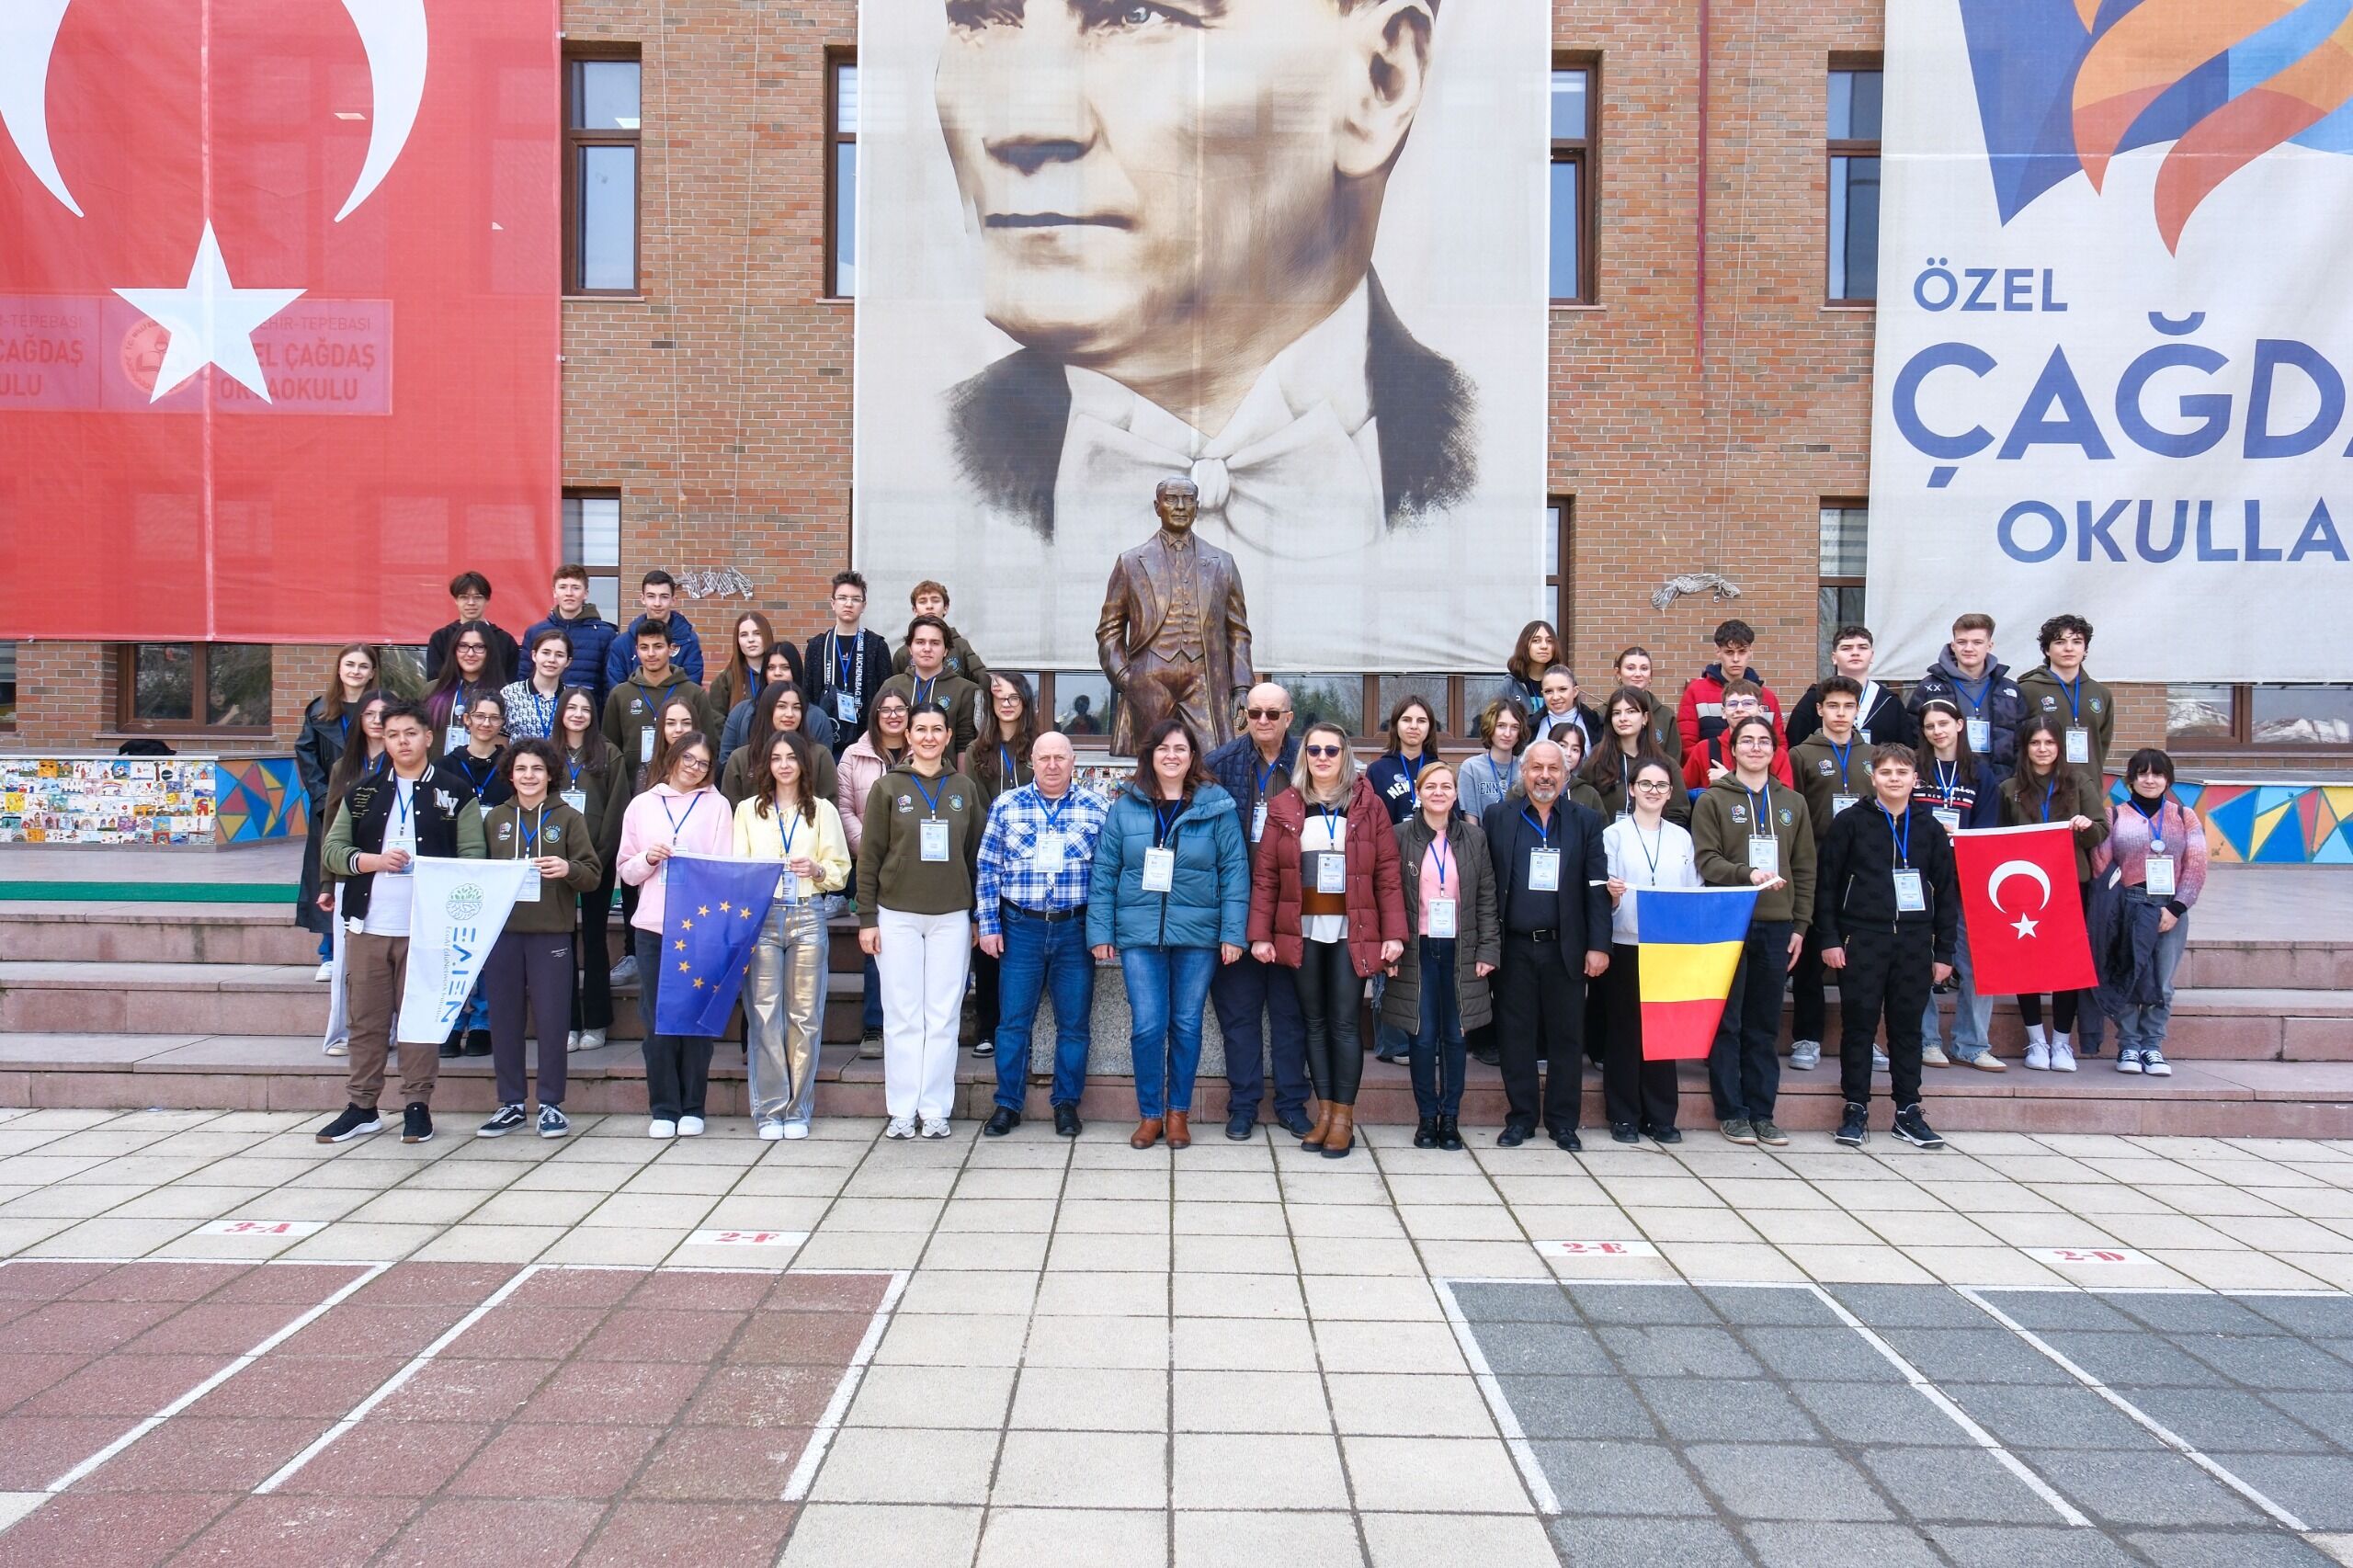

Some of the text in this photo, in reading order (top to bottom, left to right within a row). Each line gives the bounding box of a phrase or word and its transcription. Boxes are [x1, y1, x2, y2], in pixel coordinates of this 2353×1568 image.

[1914, 256, 2068, 312] ÖZEL
[284, 336, 376, 372] ÇAĞDAŞ
[220, 378, 358, 402] ORAOKULU
[1893, 312, 2353, 488] ÇAĞD
[1997, 497, 2349, 563] OKULLA
[434, 787, 460, 817] NY
[1386, 780, 1410, 800] NEW
